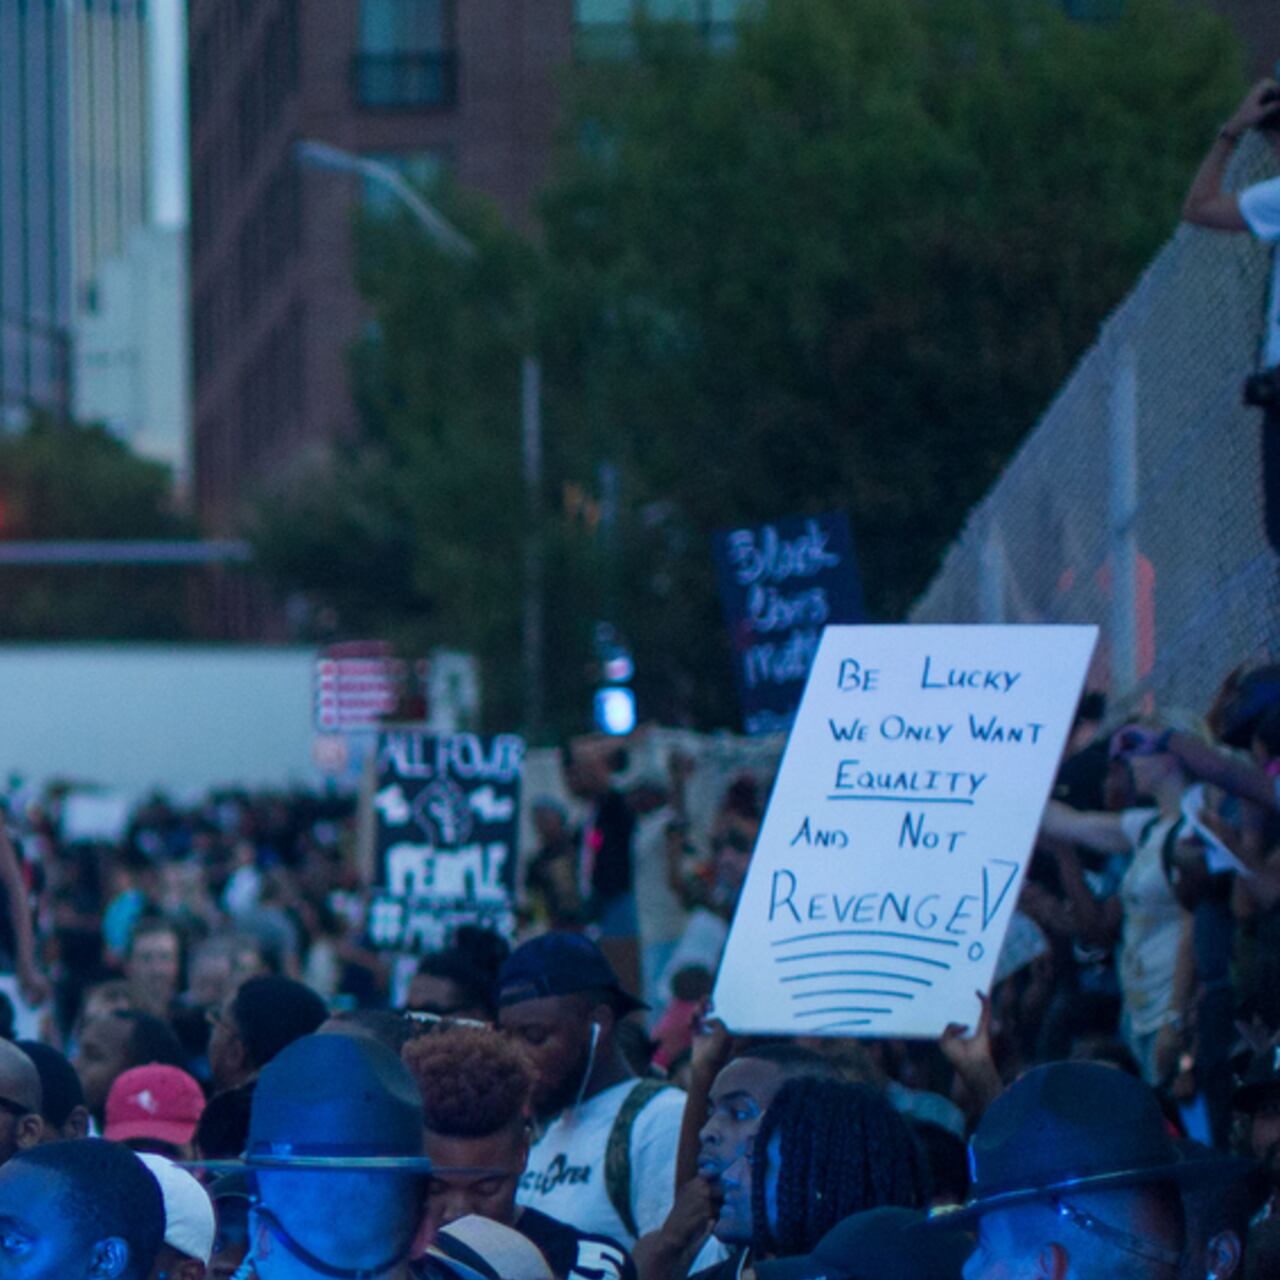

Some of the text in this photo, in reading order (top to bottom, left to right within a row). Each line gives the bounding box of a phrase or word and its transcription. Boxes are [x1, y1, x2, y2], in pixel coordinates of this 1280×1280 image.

[837, 655, 1022, 693] BE LUCKY
[828, 717, 868, 743] WE
[879, 714, 953, 744] ONLY
[968, 713, 1045, 744] WANT
[834, 758, 987, 796] EQUALITY
[790, 810, 967, 853] AND NOT
